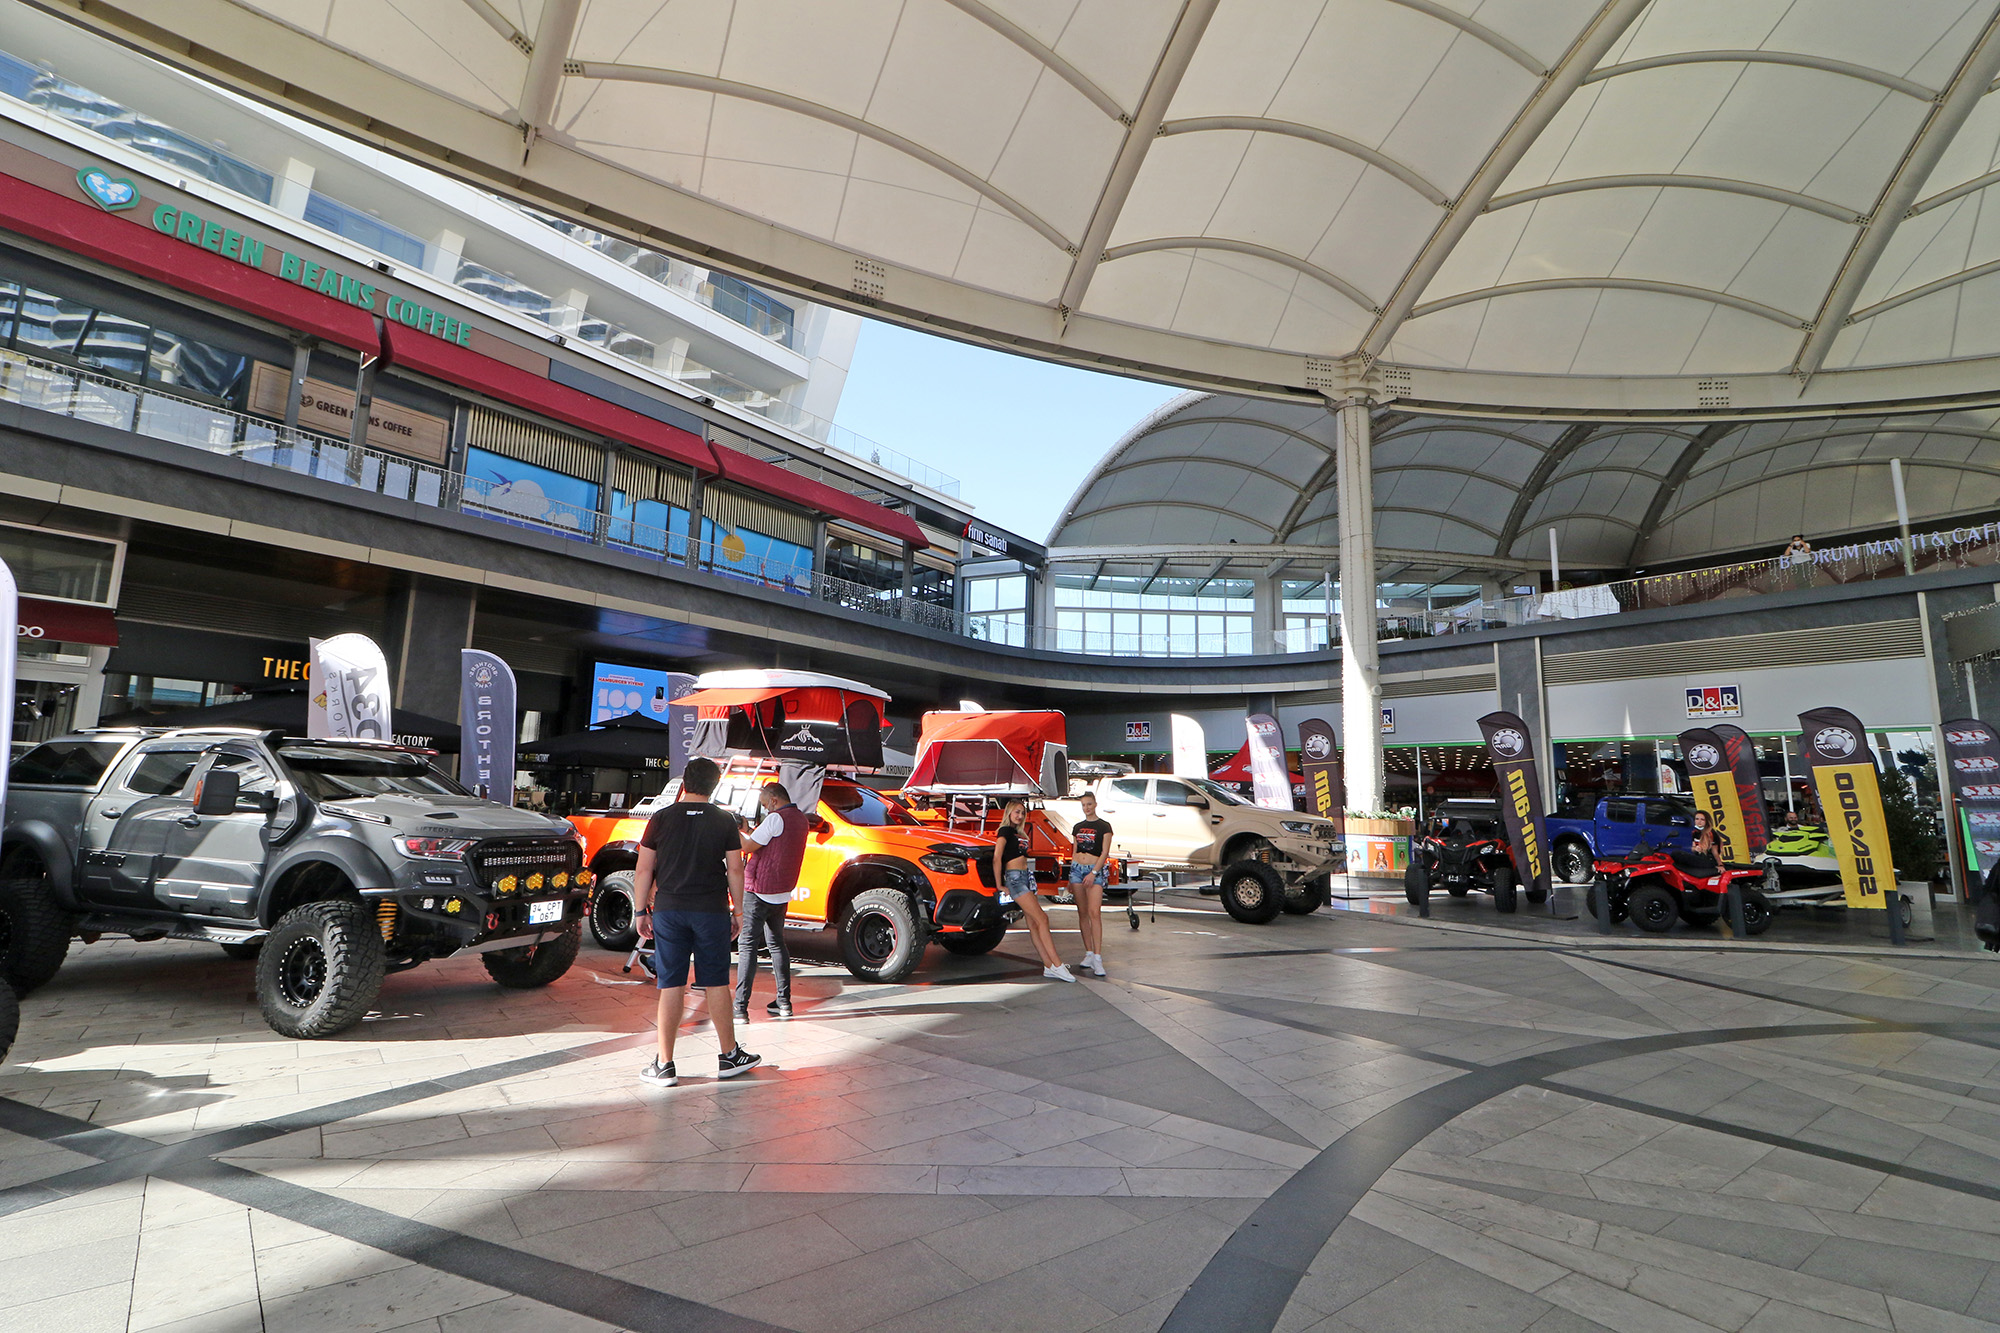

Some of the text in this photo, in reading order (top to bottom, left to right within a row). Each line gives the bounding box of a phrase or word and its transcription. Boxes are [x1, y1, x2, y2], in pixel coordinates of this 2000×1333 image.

[152, 203, 472, 346] GREEN BEANS COFFEE
[316, 401, 347, 418] GREEN
[383, 420, 412, 437] COFFEE
[597, 688, 642, 710] 100
[1688, 693, 1737, 710] D&R
[1127, 726, 1150, 737] D&R
[532, 901, 561, 912] 34 CPT
[540, 912, 554, 921] 067
